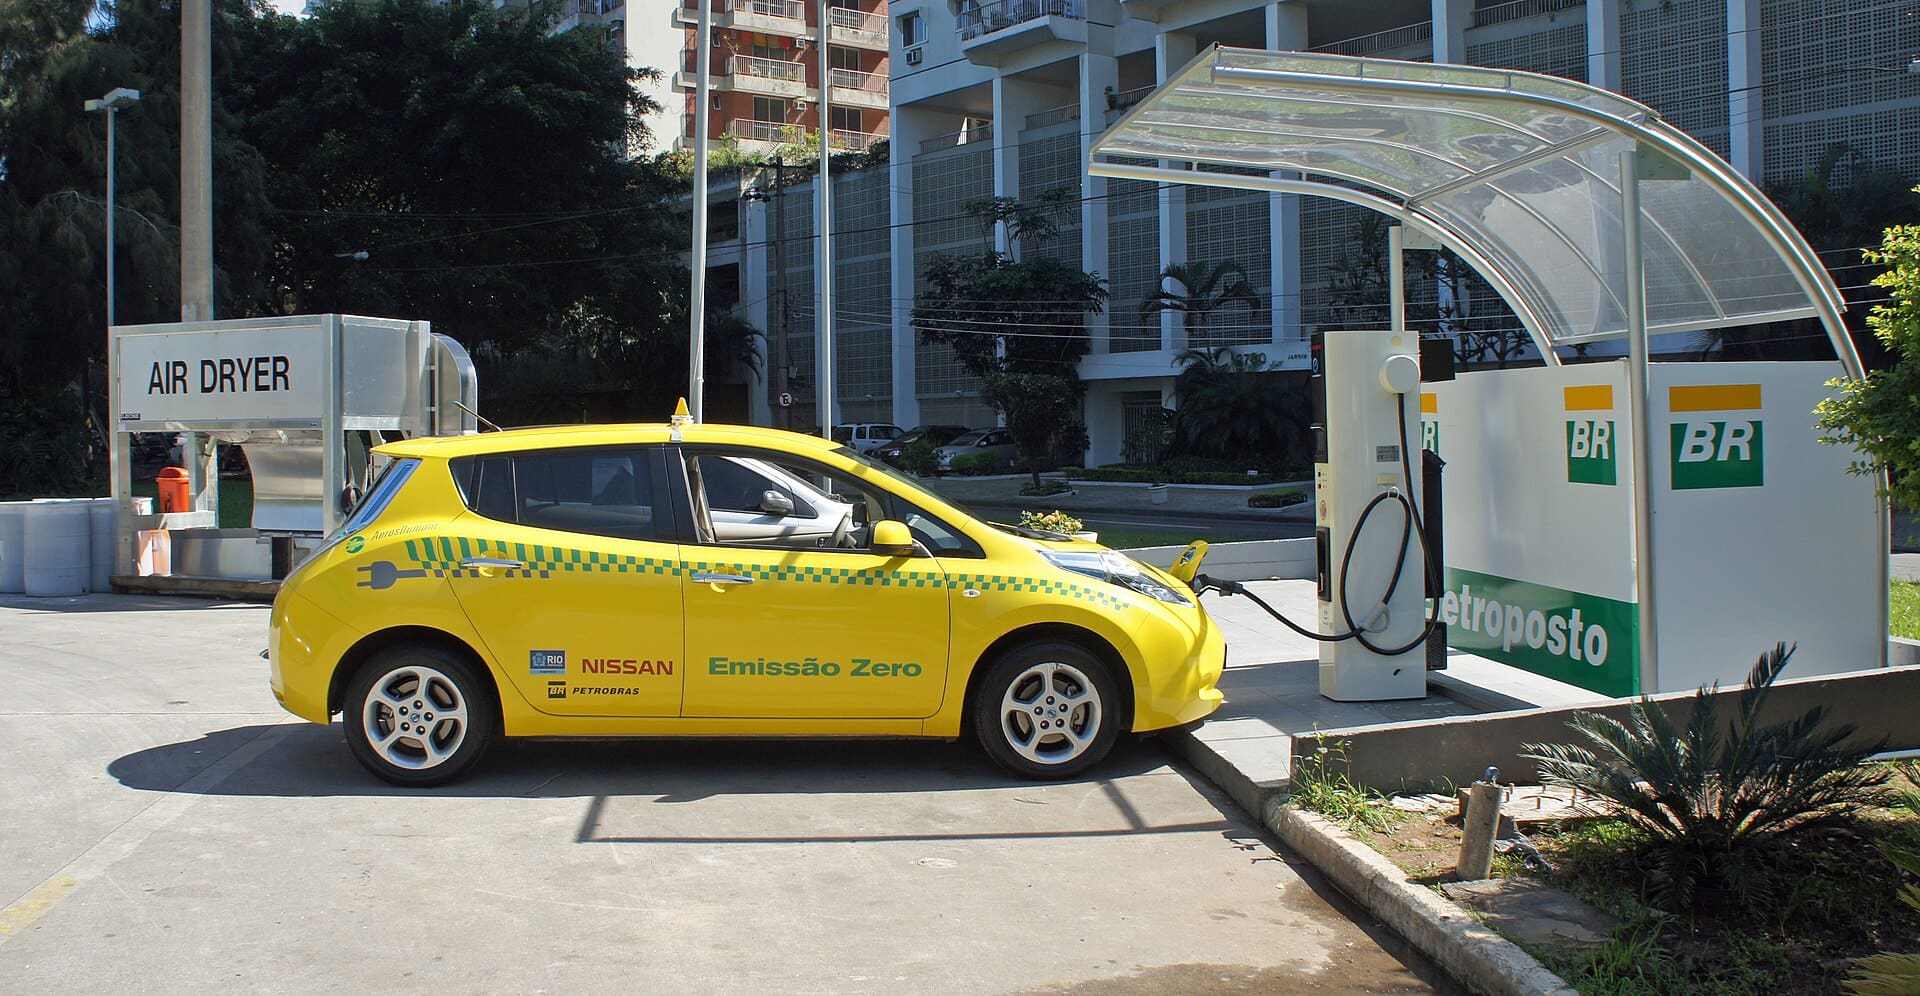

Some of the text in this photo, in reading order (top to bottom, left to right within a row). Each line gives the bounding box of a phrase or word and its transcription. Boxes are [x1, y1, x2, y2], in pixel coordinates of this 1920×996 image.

[148, 356, 290, 395] AIR DRYER
[1570, 420, 1610, 460] BR
[1679, 421, 1754, 463] BR
[1425, 584, 1608, 667] etroposto
[547, 655, 563, 664] RIO
[582, 659, 673, 675] NISSAN
[708, 656, 923, 677] Emissão Zero
[549, 687, 640, 695] BR PETROBRAS
